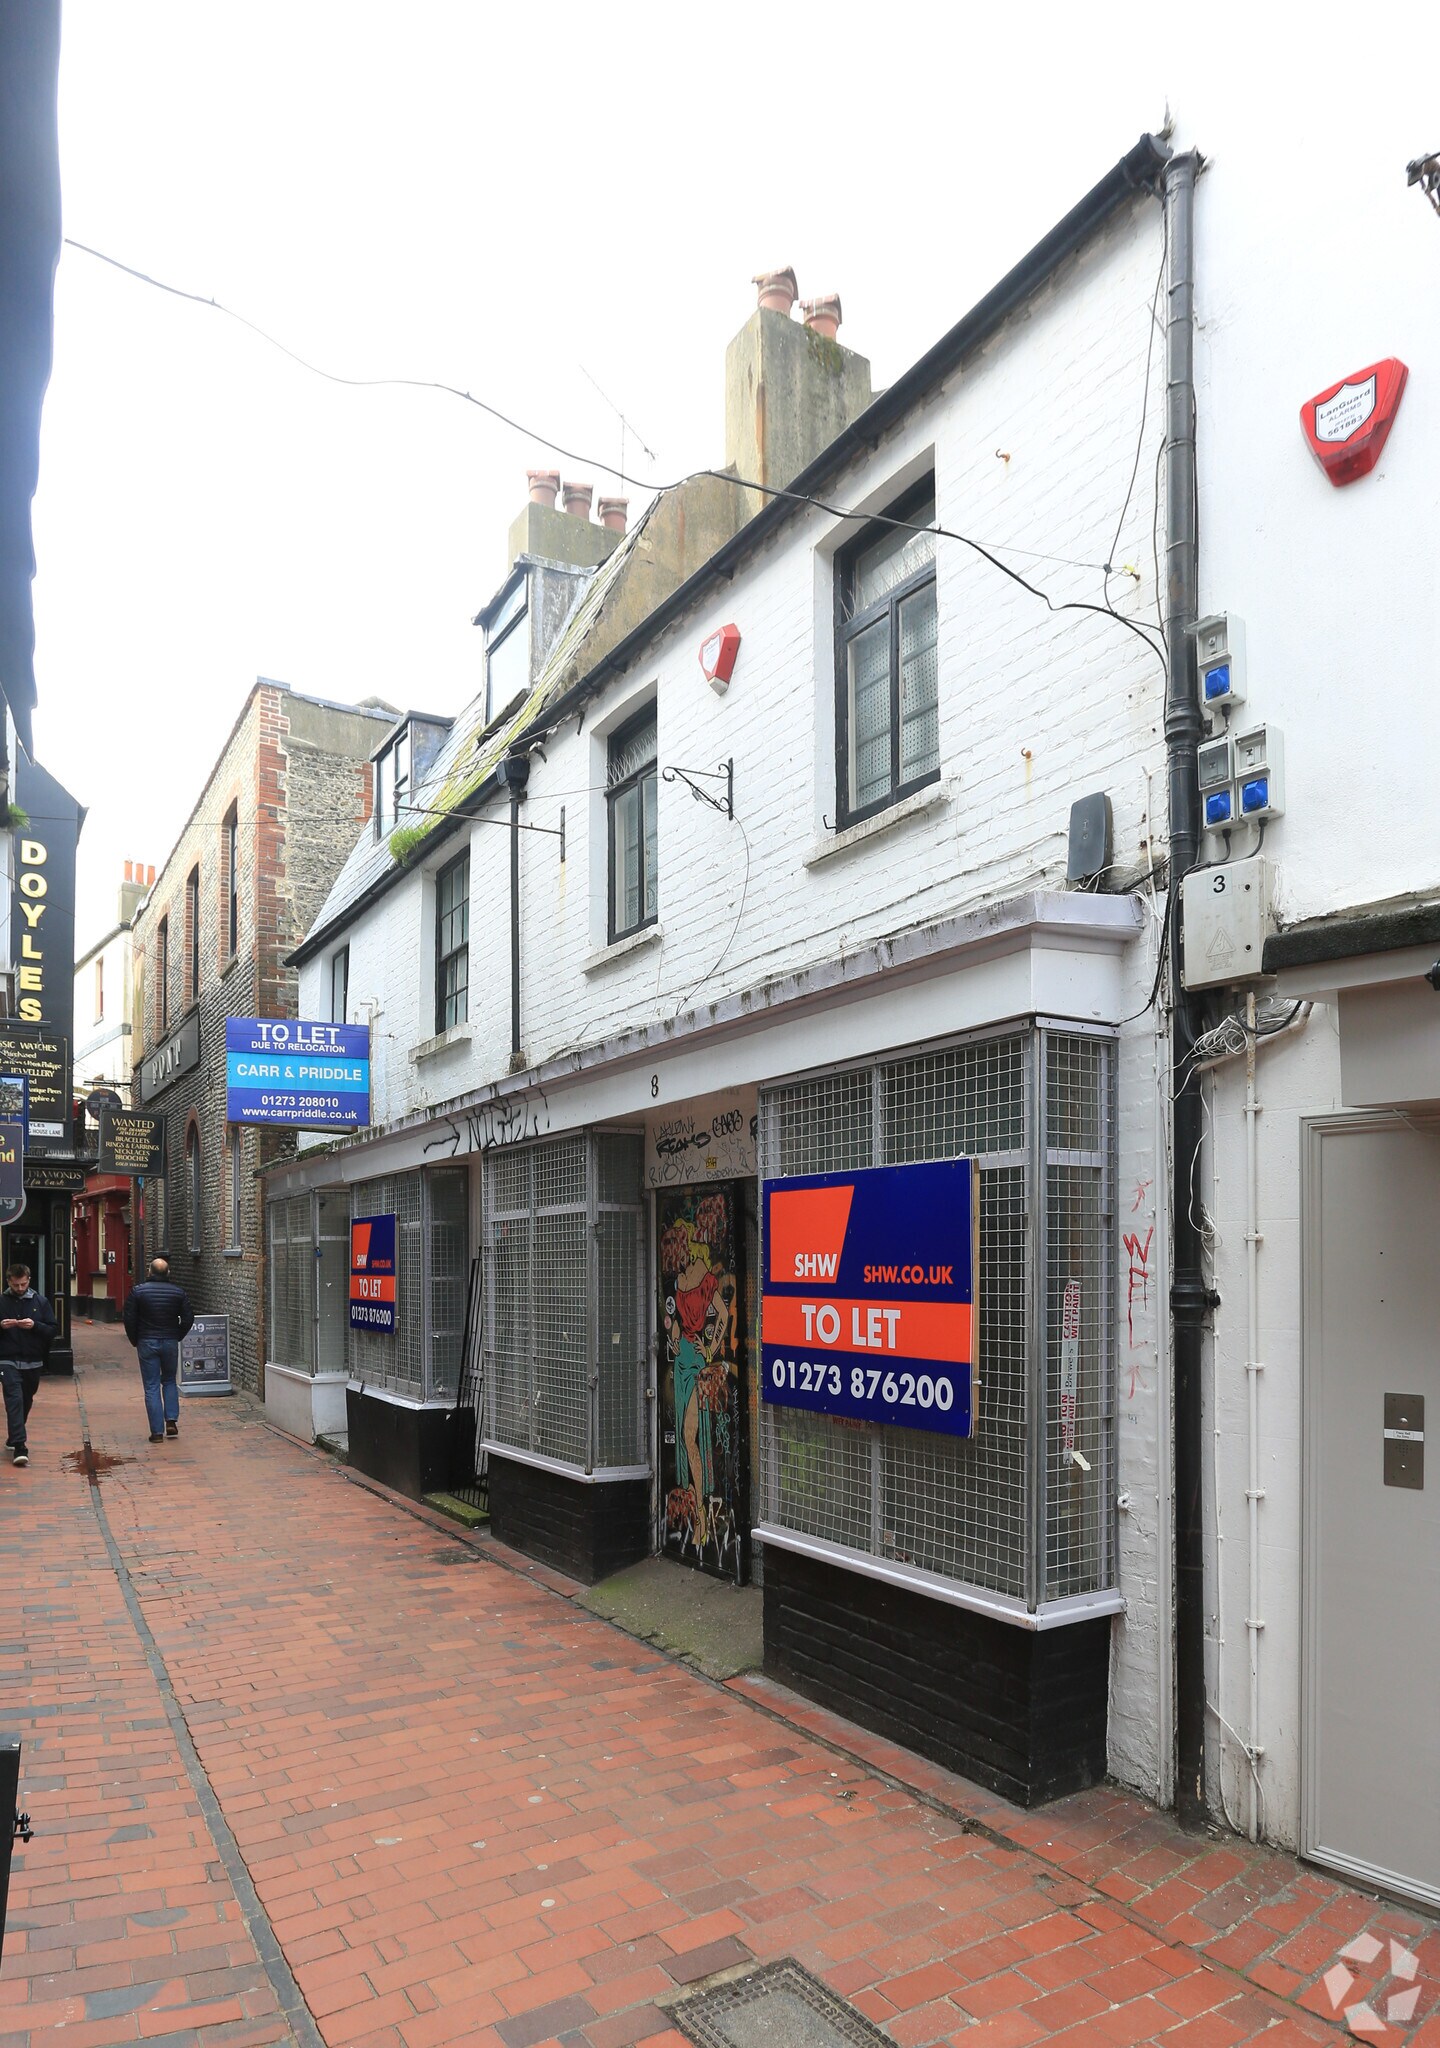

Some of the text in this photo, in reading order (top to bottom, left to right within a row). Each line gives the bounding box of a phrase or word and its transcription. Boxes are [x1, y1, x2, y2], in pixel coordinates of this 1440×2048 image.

[1213, 875, 1226, 893] 3
[19, 840, 48, 1022] DOYLES
[257, 1024, 340, 1045] TO LET
[20, 1042, 58, 1052] WATCHES
[251, 1041, 346, 1053] DUE TO RELOCATION
[236, 1064, 362, 1081] CARR & PRIDDLE
[651, 1074, 659, 1098] 8
[261, 1095, 339, 1108] 01273 208010
[242, 1108, 358, 1120] www.carrpriddle.co.uk
[111, 1117, 155, 1128] WANTED
[105, 1141, 124, 1149] RINGS
[115, 1136, 150, 1144] BRACELETS
[114, 1148, 150, 1156] NECKLACES
[115, 1154, 149, 1162] BROOCHES
[28, 1170, 82, 1180] DIAMONDS
[357, 1254, 367, 1266] SHW
[794, 1253, 838, 1278] SHW
[863, 1264, 954, 1285] SHW.CO.UK
[359, 1278, 381, 1298] TO LET
[352, 1305, 392, 1326] 01273 876200
[801, 1304, 901, 1349] TO LET
[772, 1358, 954, 1412] 01273 876200
